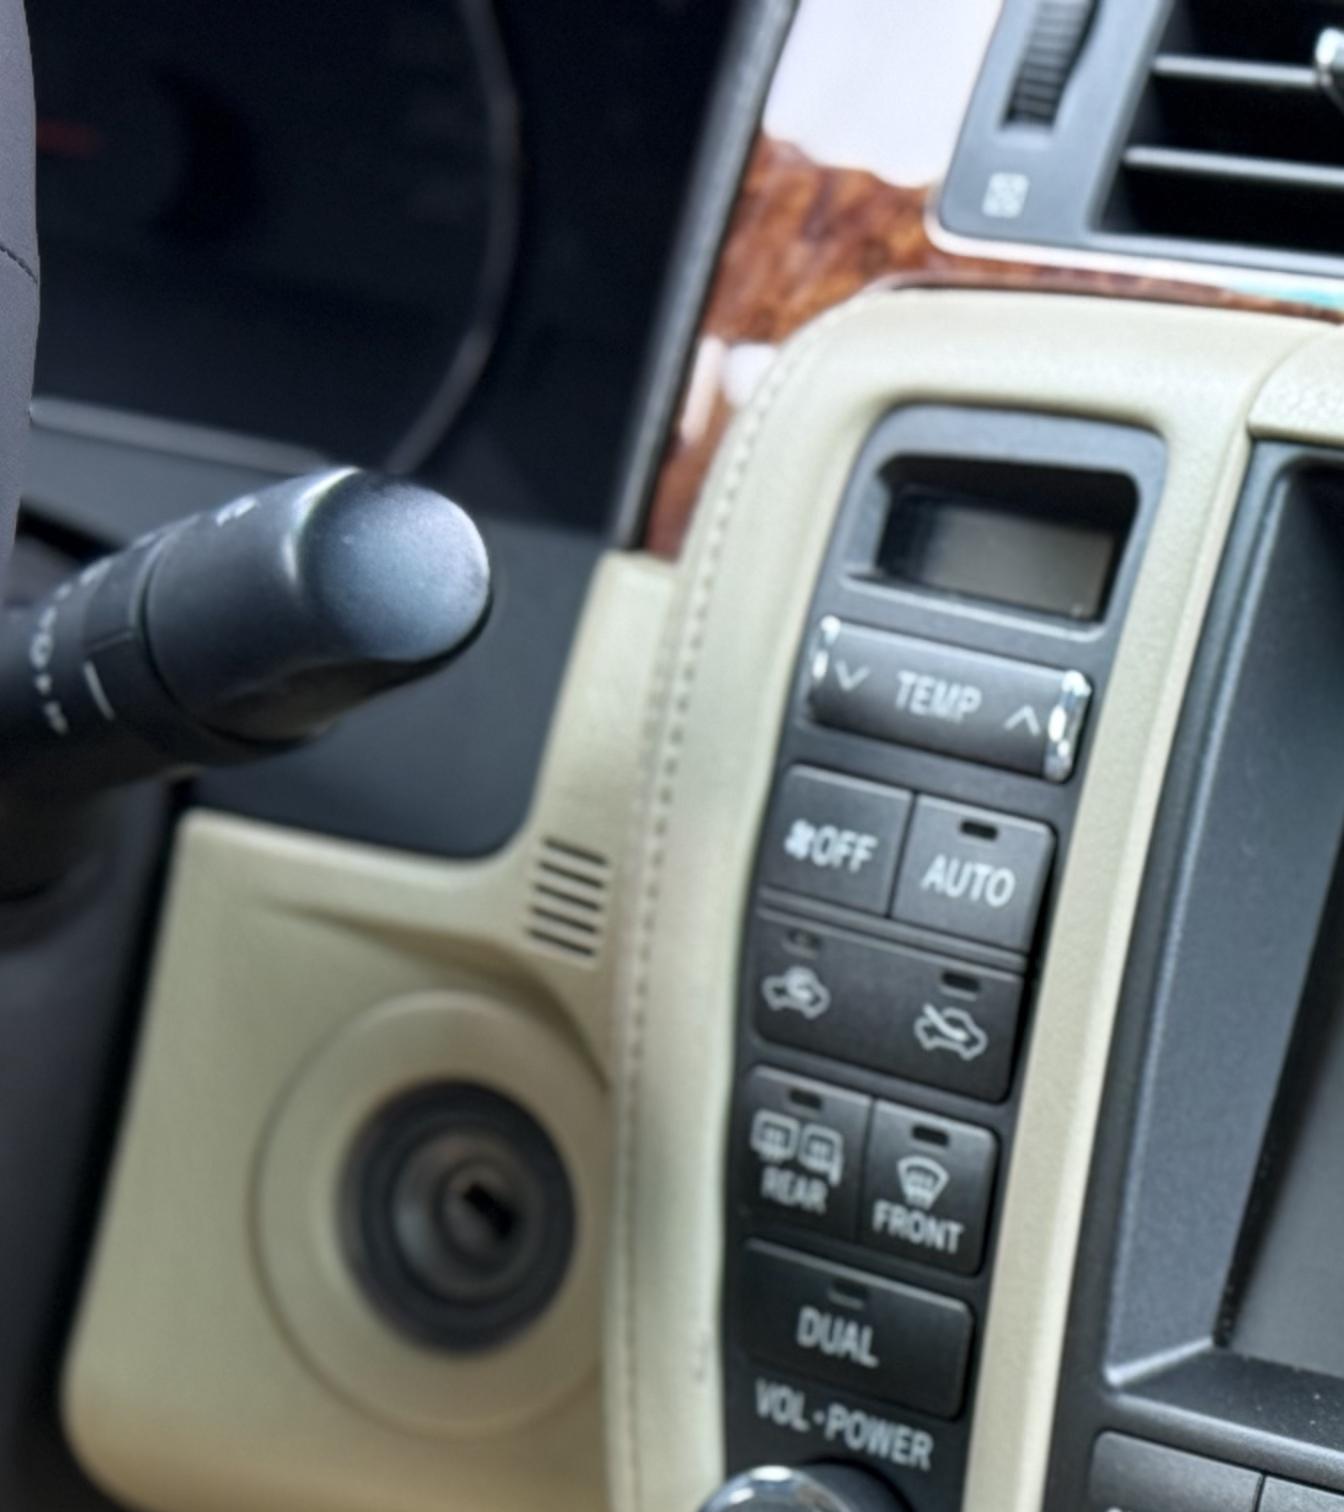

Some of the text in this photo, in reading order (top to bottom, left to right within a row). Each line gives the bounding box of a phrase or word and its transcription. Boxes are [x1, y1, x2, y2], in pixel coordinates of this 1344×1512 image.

[895, 669, 983, 724] TEMP
[811, 826, 879, 873] OFF
[919, 853, 1015, 907] AUTO
[760, 1164, 828, 1215] REAR
[872, 1199, 963, 1254] FRONT
[797, 1305, 880, 1369] DUAL
